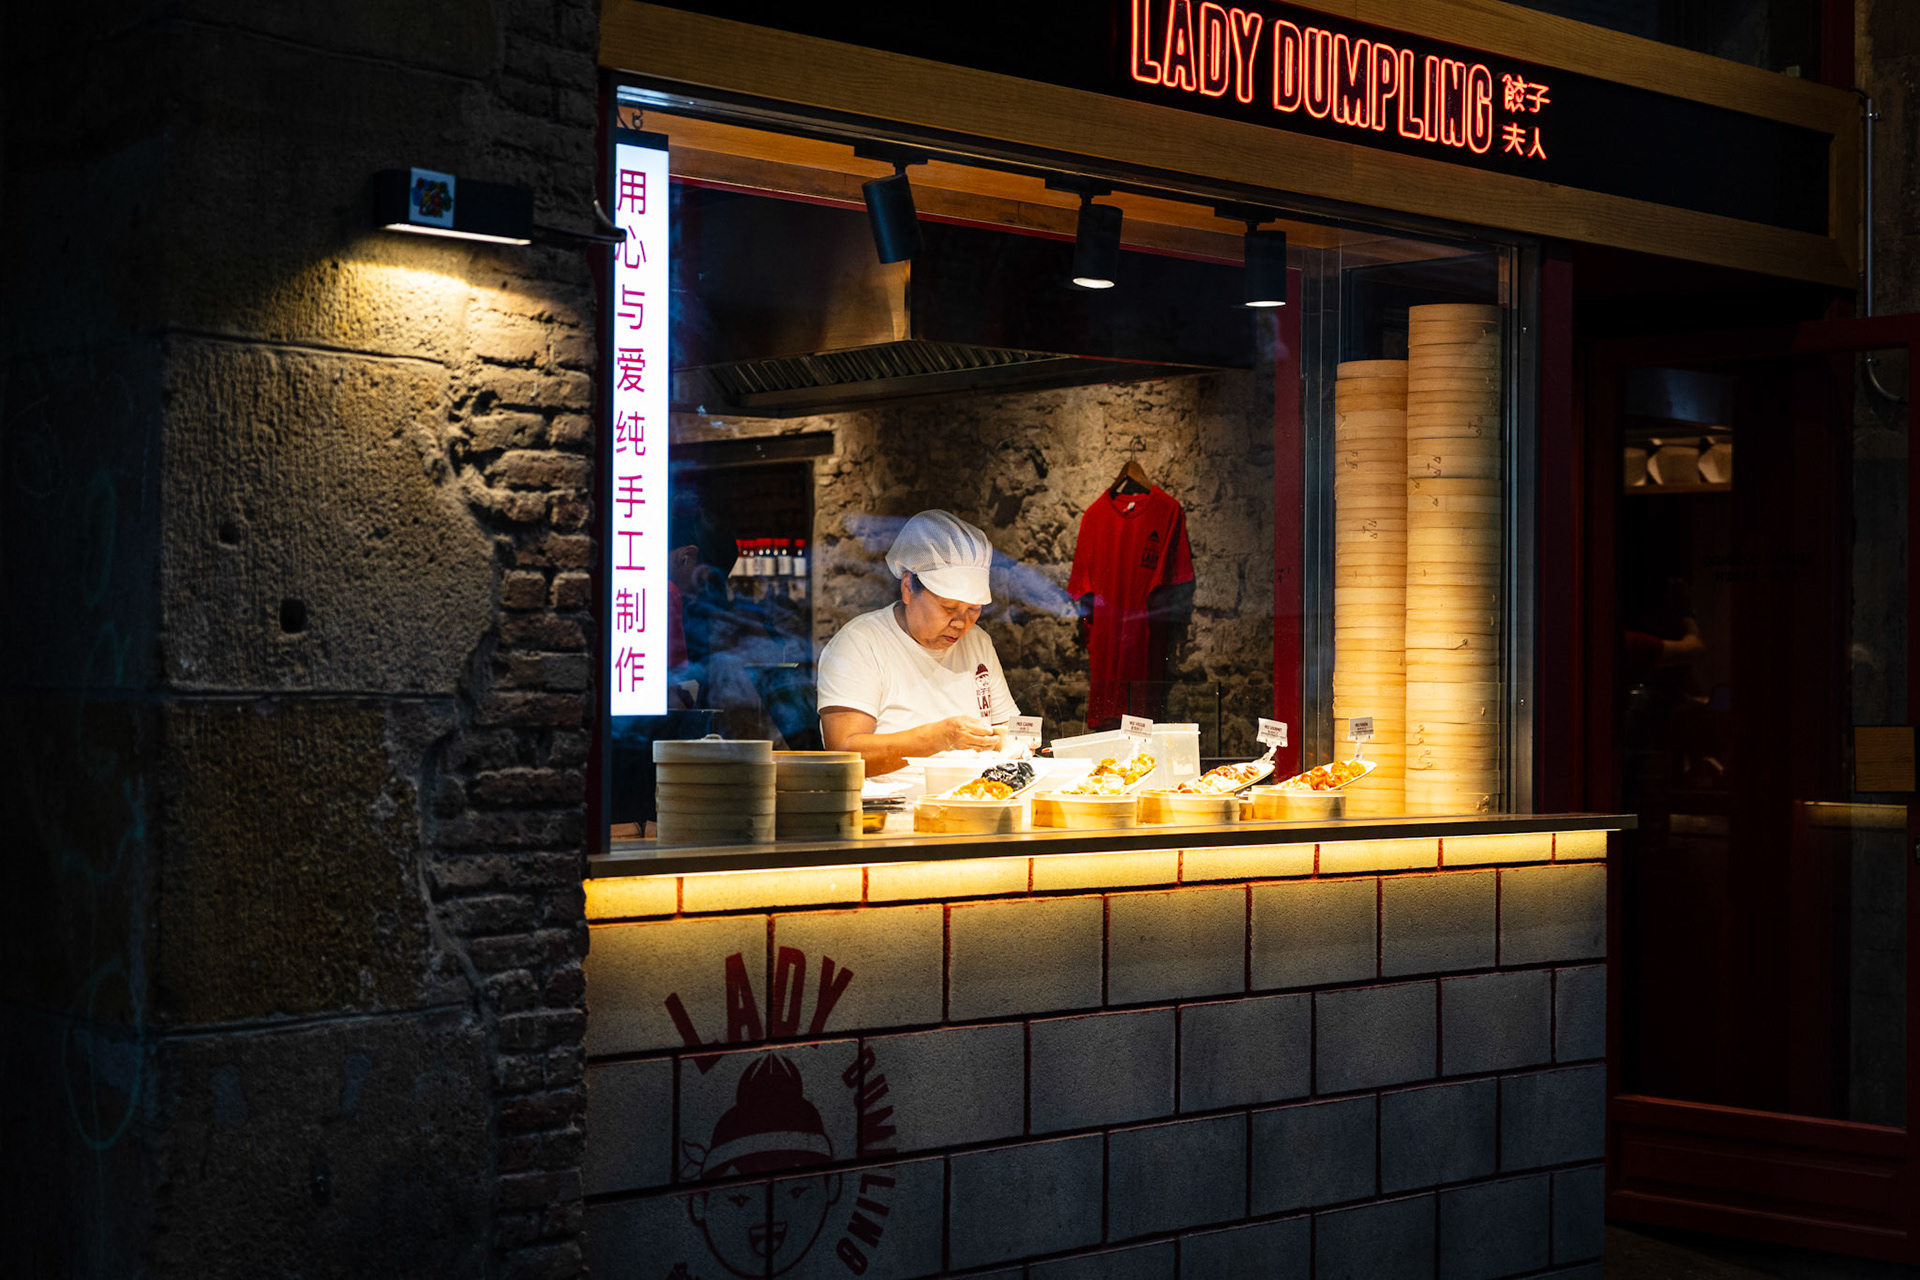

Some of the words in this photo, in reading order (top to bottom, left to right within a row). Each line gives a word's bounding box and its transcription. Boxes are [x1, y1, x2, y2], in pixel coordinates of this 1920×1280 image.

[1131, 0, 1262, 103] LADY
[1273, 20, 1493, 154] DUMPLING
[1502, 73, 1551, 113] 餃子
[1502, 122, 1547, 160] 夫人
[615, 168, 647, 693] 用心与爱纯手工制作
[664, 946, 854, 1075] LADY
